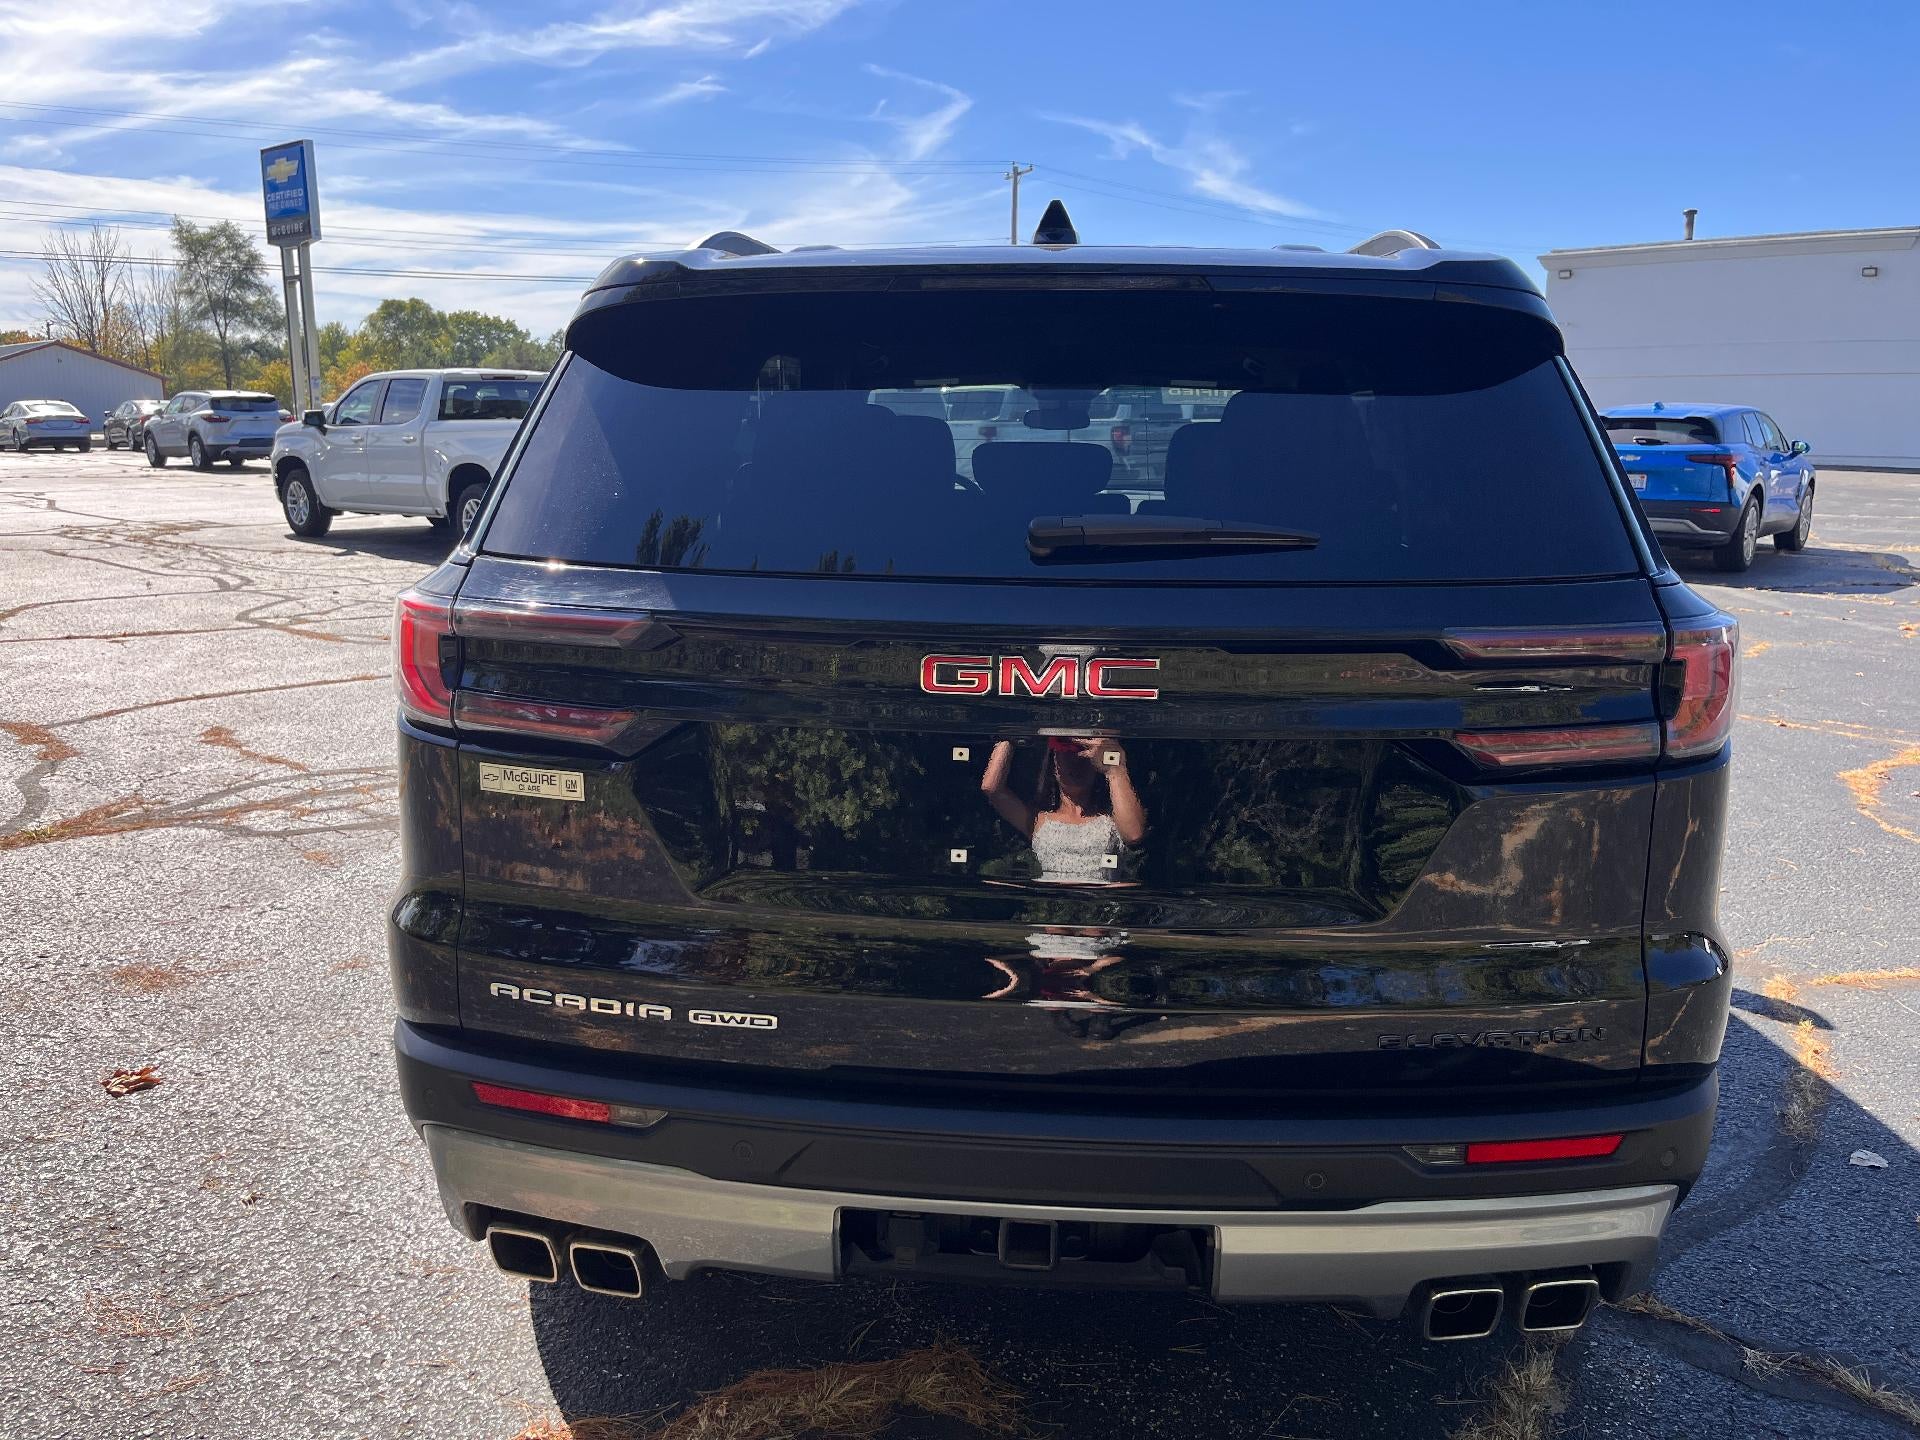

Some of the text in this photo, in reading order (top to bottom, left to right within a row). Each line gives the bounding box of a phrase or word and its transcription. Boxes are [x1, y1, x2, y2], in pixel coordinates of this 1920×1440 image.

[266, 188, 304, 201] CERTIFIED
[921, 654, 1160, 699] GMC
[503, 770, 578, 790] McGUIRE GM
[490, 982, 774, 1026] ACADIA AWD
[1378, 1026, 1608, 1049] ELEVATION
